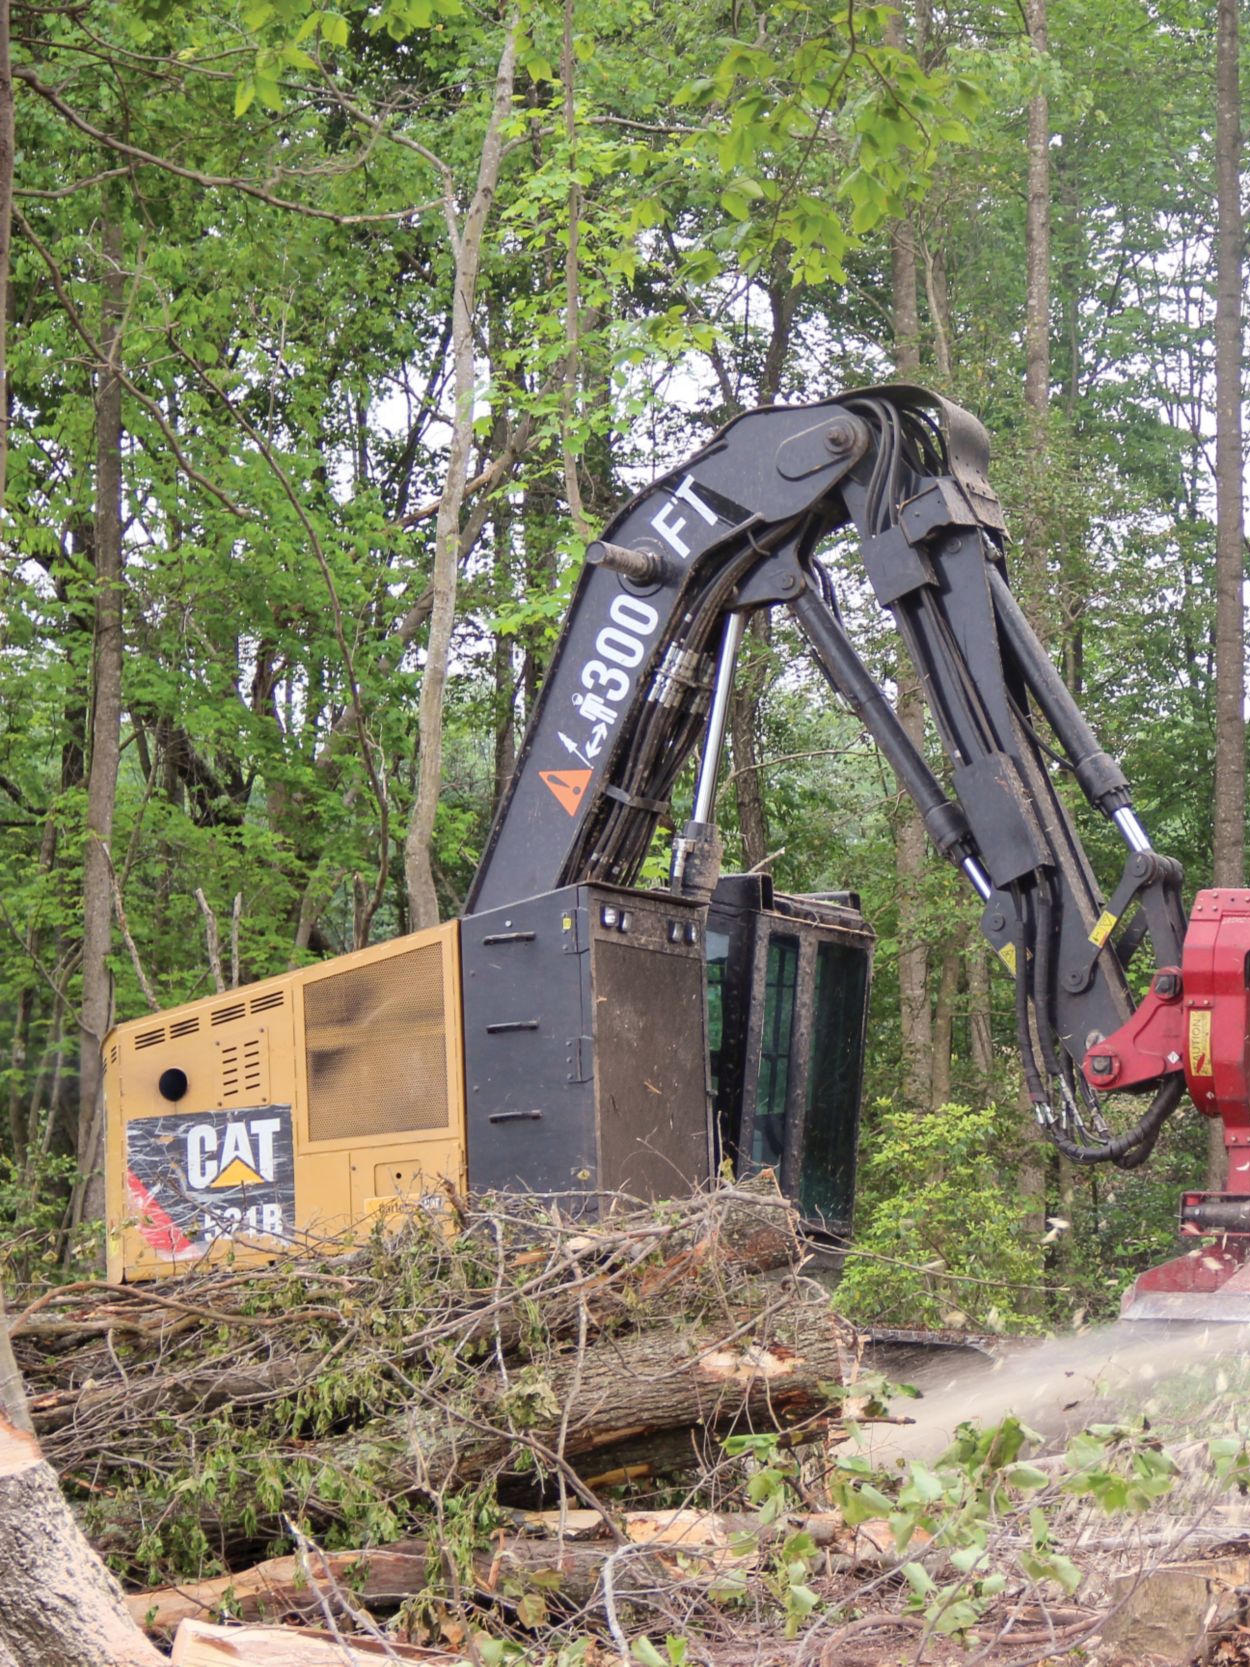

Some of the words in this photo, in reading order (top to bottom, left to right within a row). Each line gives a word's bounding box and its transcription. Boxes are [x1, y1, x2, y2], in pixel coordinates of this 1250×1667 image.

[581, 593, 659, 703] 300
[651, 474, 718, 559] FT
[1191, 1019, 1201, 1068] AUTION
[187, 1118, 281, 1190] CAT
[204, 1203, 284, 1242] 521B
